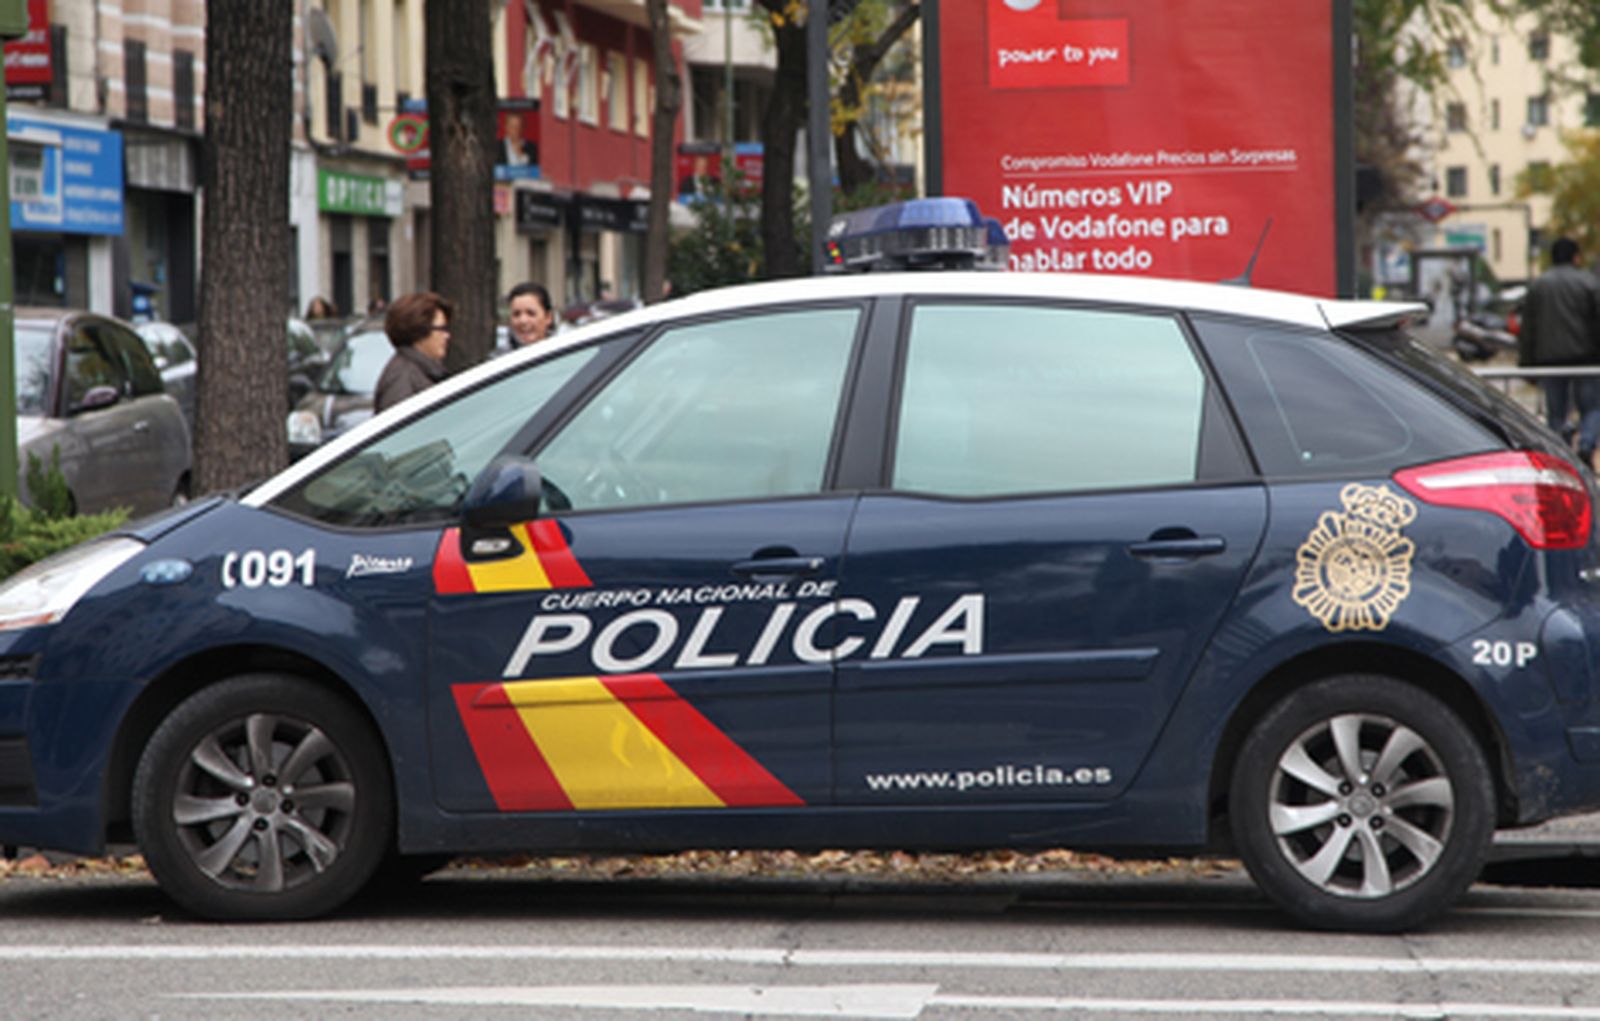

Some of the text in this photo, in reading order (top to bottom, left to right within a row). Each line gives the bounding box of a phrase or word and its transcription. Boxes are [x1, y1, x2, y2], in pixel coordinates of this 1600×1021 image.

[998, 44, 1119, 68] power to you
[1001, 148, 1297, 172] Compromiso Vodafone Precios sin Sorpresas
[1002, 180, 1172, 209] Números VIP
[1003, 214, 1229, 241] de Vodafone para
[1092, 247, 1153, 271] todo
[541, 580, 837, 610] CUERPO NACIONAL DE
[502, 594, 985, 679] POLICIA
[1472, 640, 1512, 665] 20
[866, 764, 1112, 790] www.policia.es
